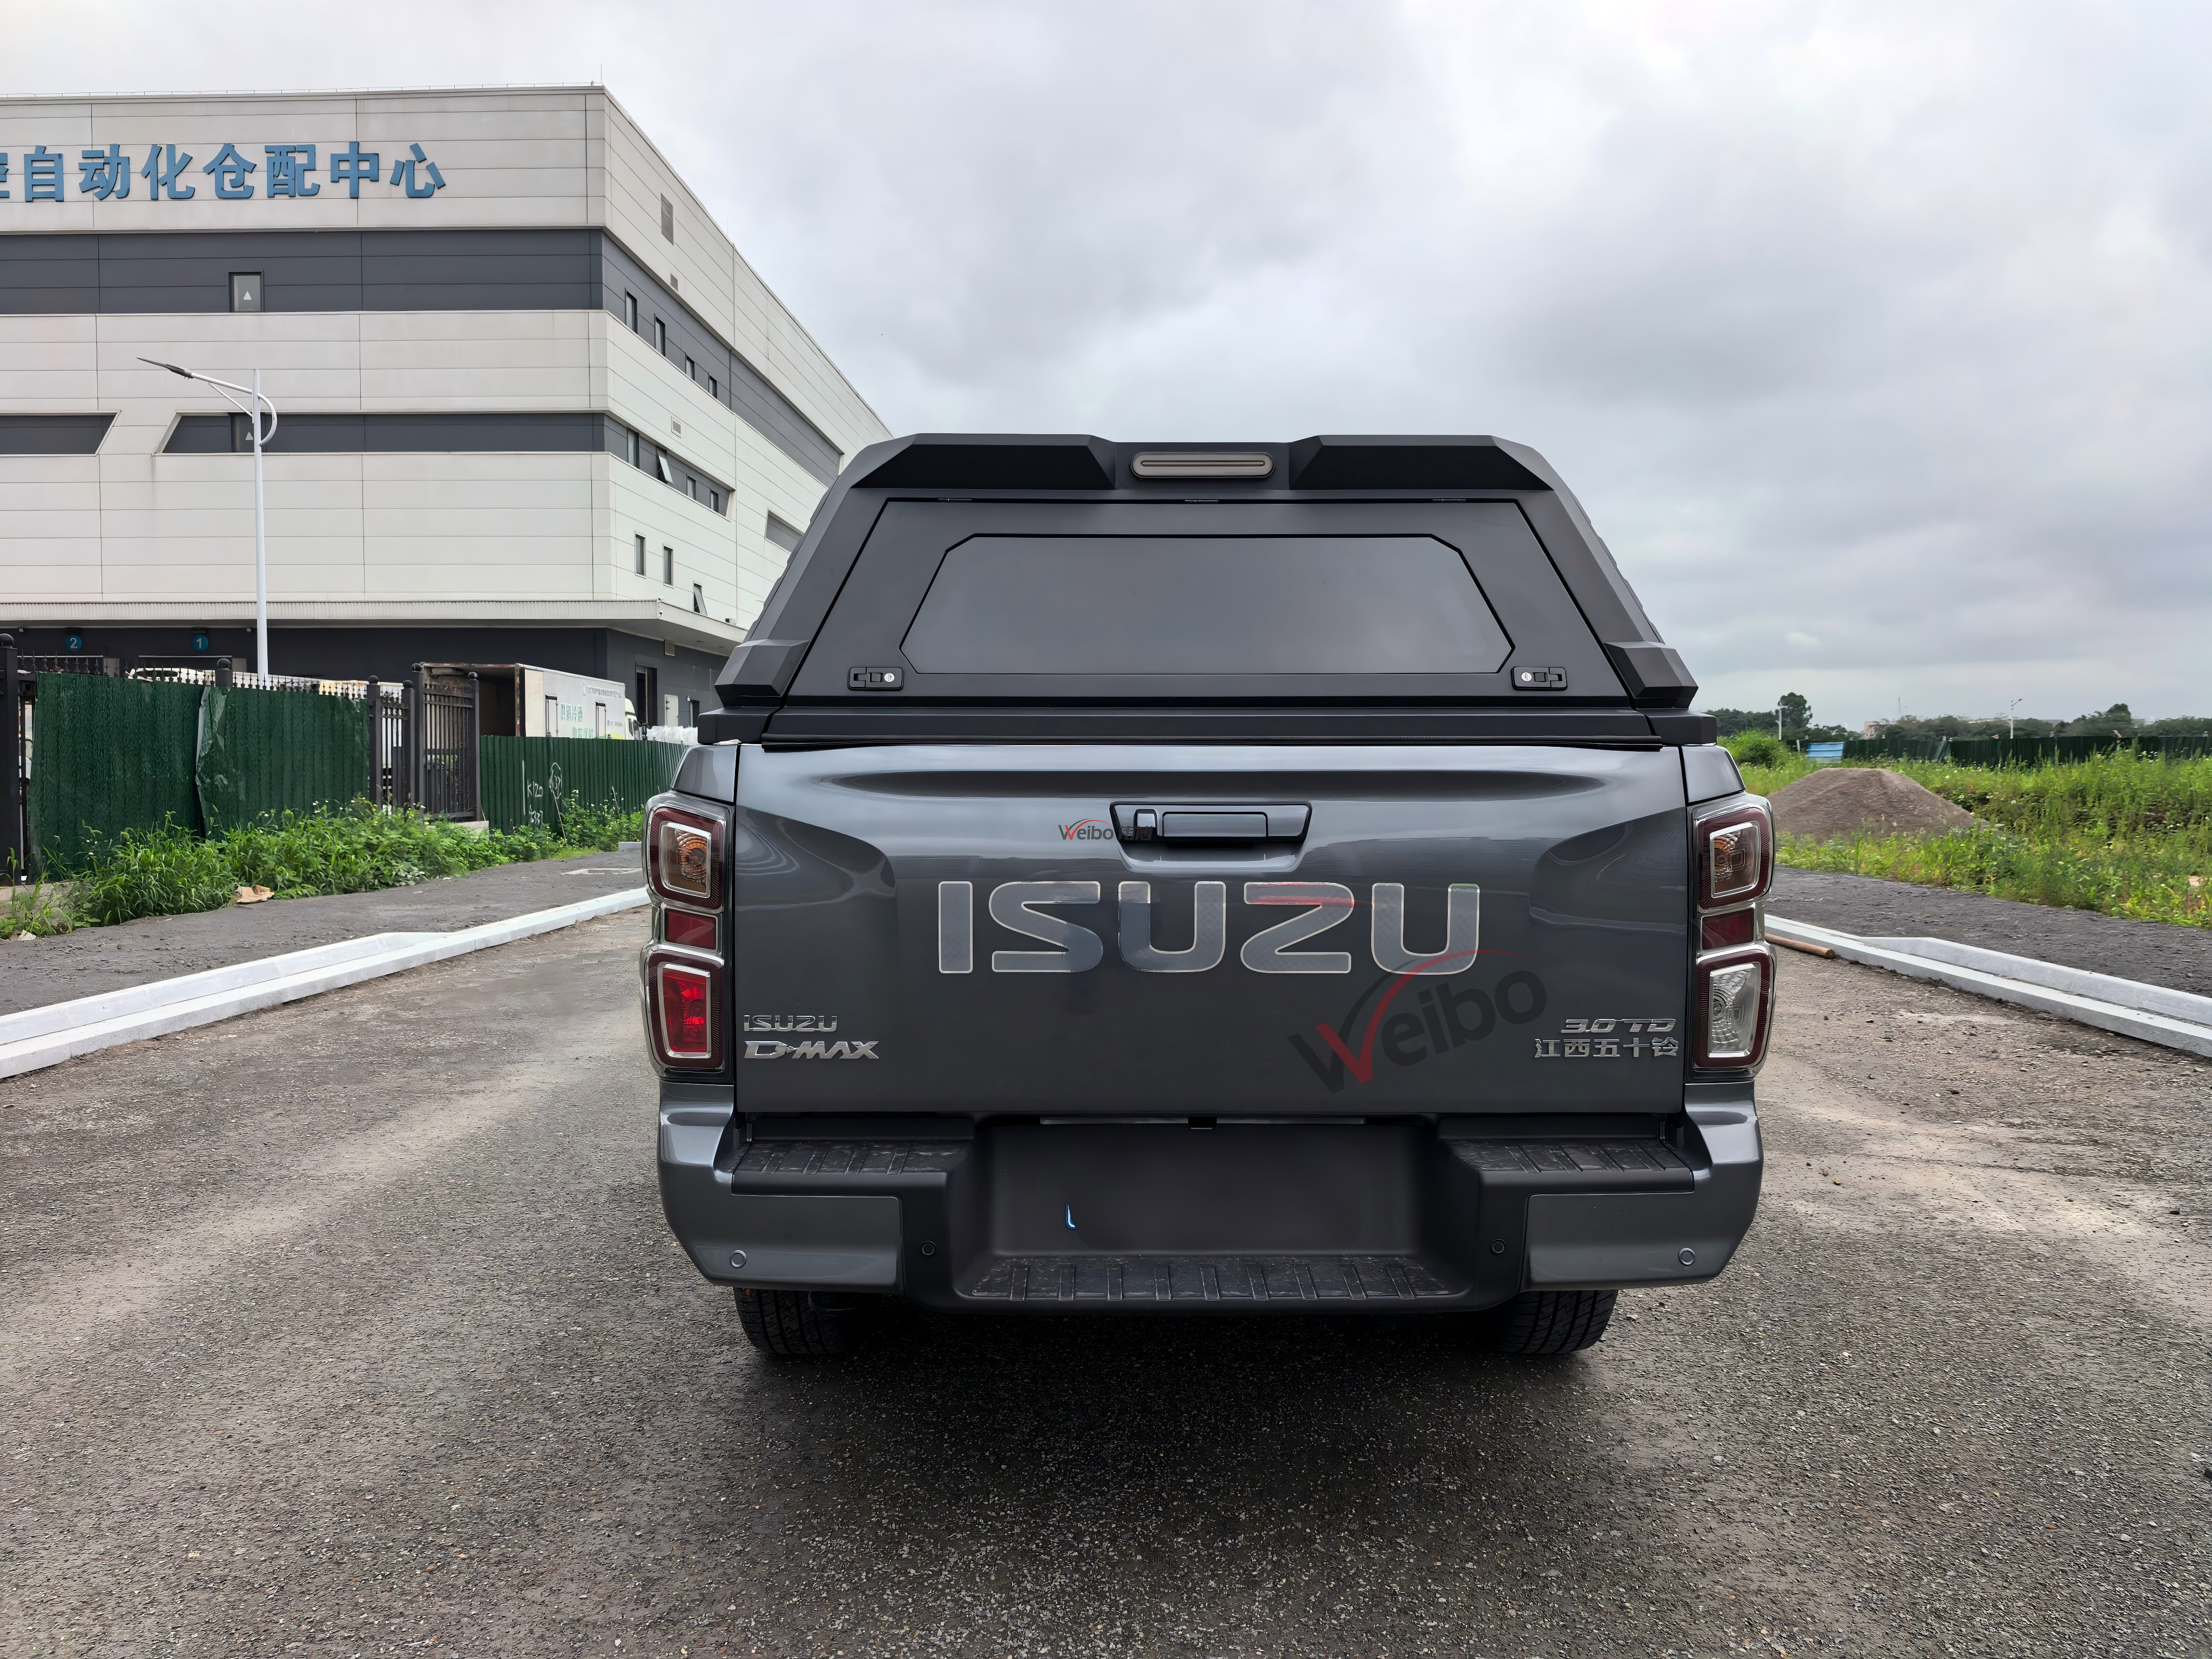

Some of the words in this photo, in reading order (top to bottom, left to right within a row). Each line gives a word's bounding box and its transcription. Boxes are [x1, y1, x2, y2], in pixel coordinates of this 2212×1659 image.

[0, 141, 446, 202] 自动化仓配中心
[70, 638, 78, 649] 2
[196, 637, 202, 649] 1
[938, 880, 1480, 975] ISUZU
[744, 1015, 838, 1032] ISUZU
[744, 1041, 879, 1059] D-MAX
[1534, 1037, 1679, 1058] 江西五十铃
